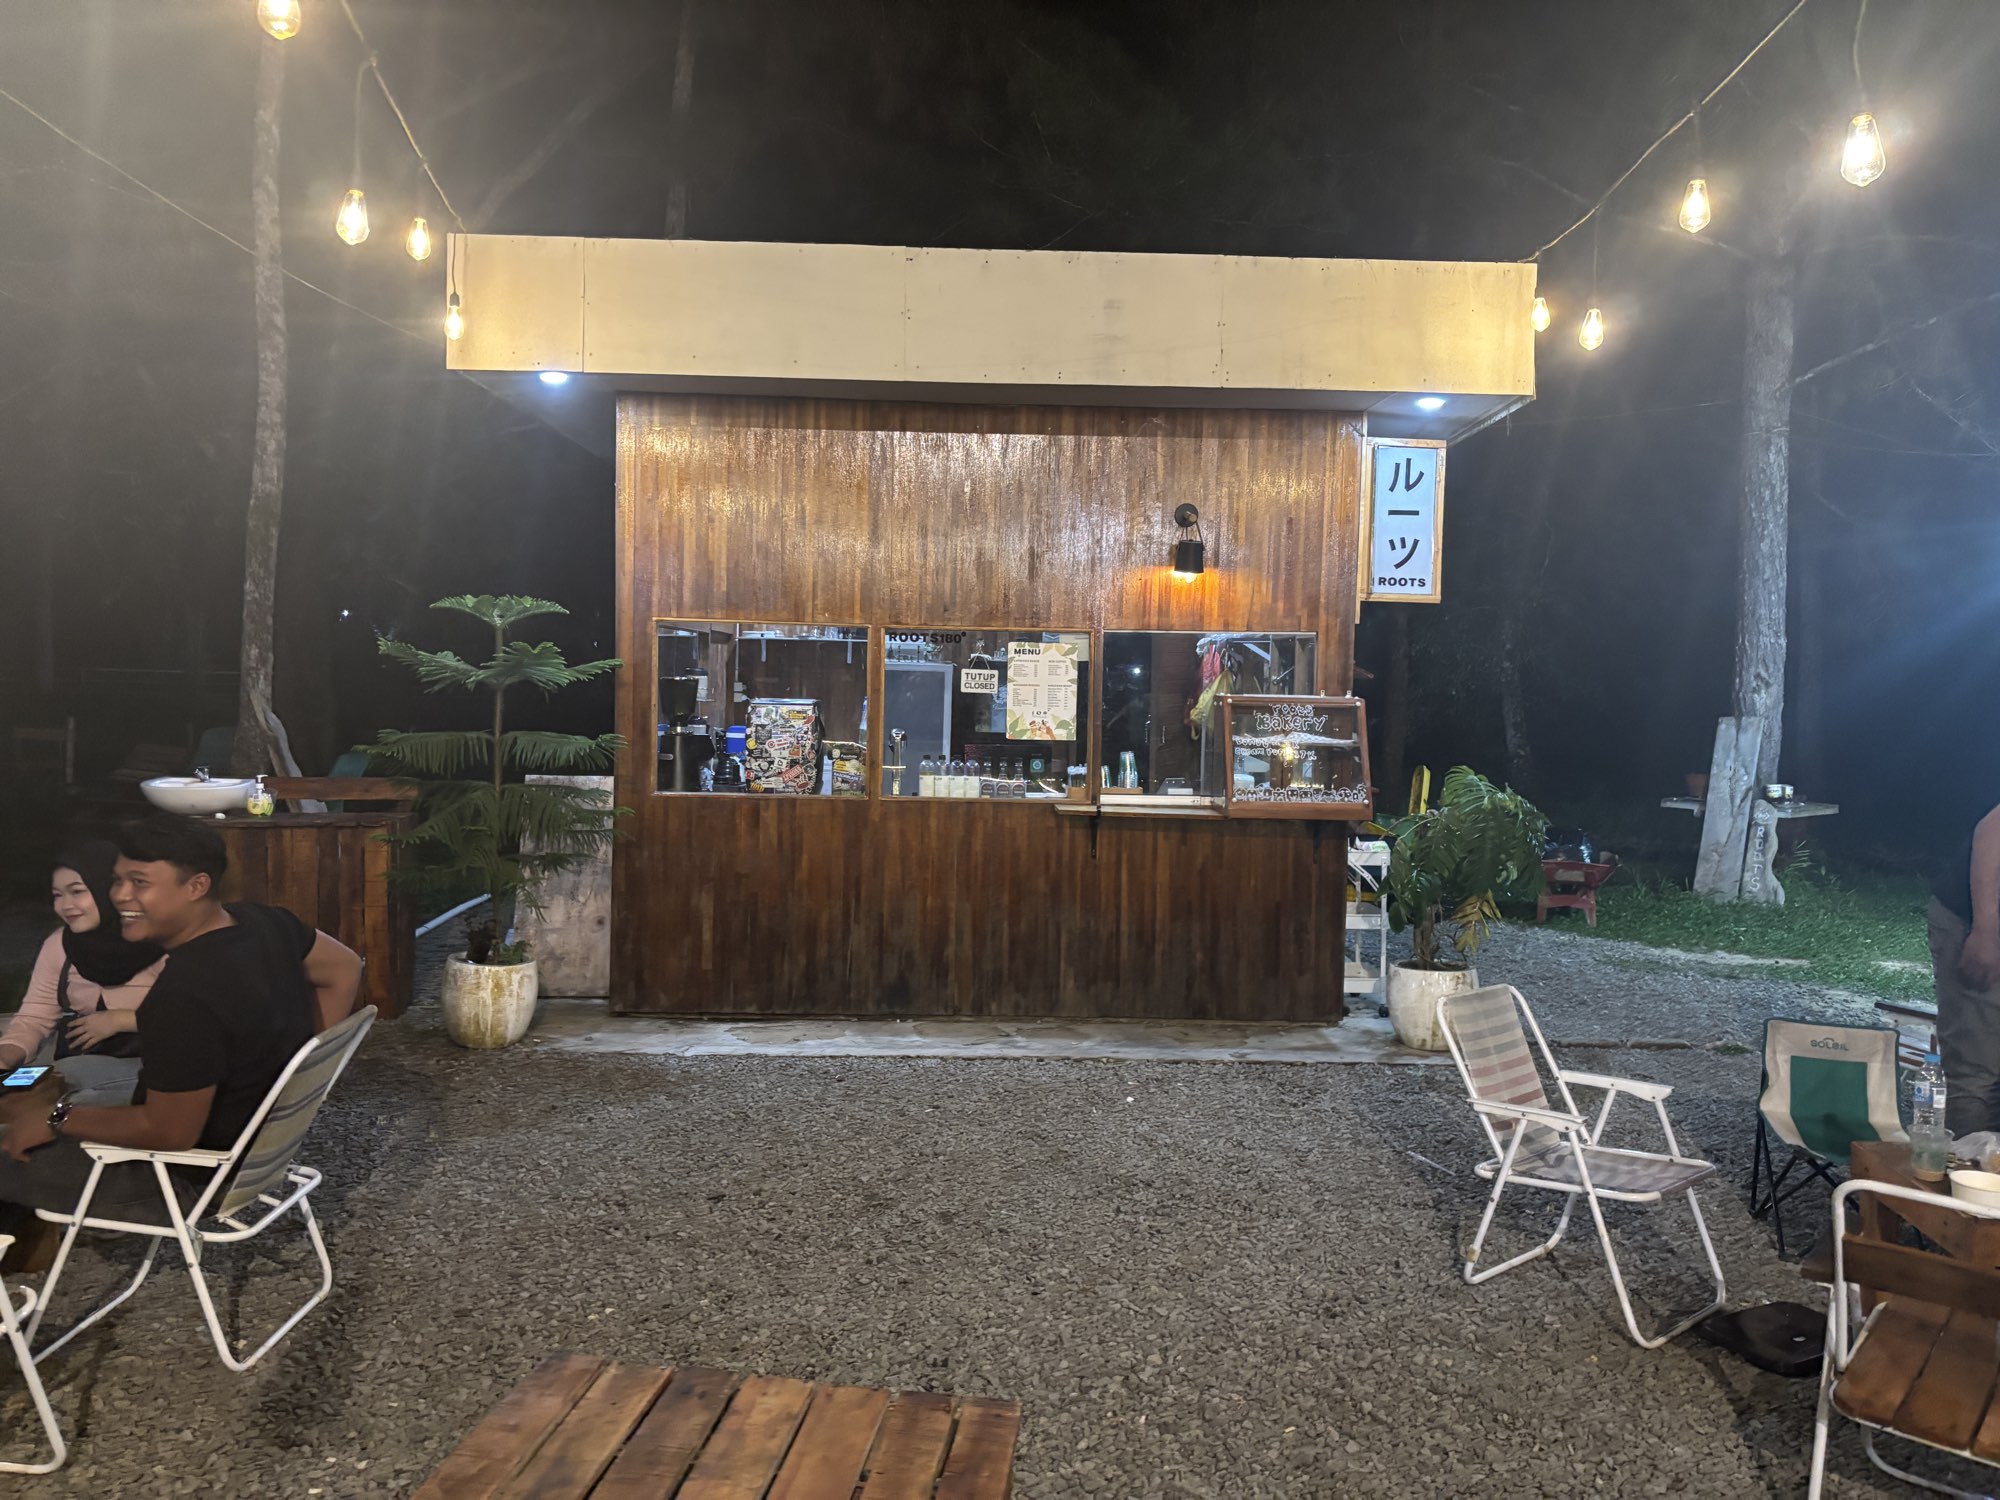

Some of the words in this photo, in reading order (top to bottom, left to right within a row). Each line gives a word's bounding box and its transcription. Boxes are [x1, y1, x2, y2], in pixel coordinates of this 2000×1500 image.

[1388, 457, 1425, 570] ルーツ
[1378, 576, 1427, 588] ROOTS
[1013, 648, 1041, 656] MENU
[964, 672, 996, 681] TUTUP
[964, 681, 996, 691] CLOSED
